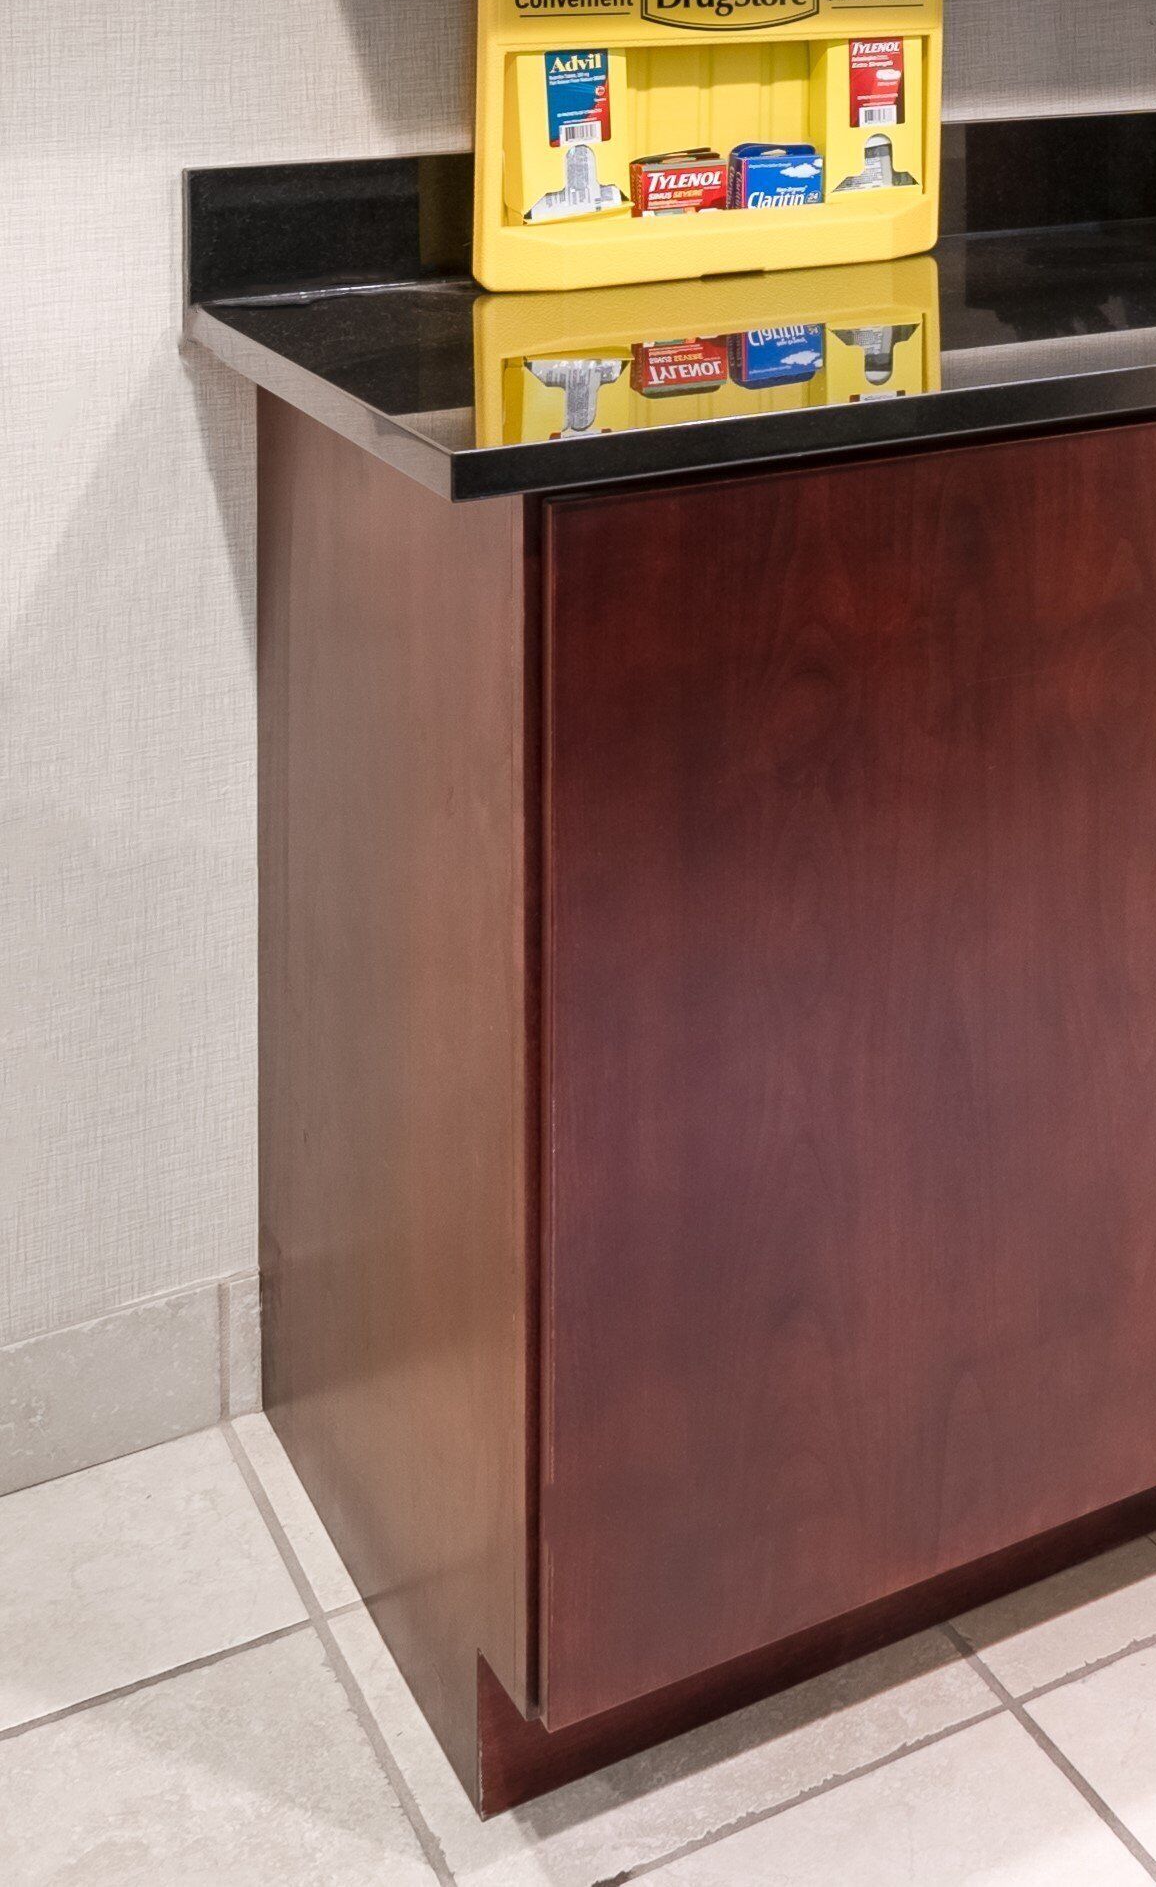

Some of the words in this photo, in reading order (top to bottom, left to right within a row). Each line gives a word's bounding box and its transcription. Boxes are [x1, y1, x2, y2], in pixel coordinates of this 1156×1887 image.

[852, 41, 900, 56] TYLENOL
[549, 53, 602, 74] Advil
[647, 171, 723, 192] TYLENOL
[648, 192, 673, 201] SINUS
[672, 188, 703, 199] SEVERE
[748, 192, 805, 210] Claritin
